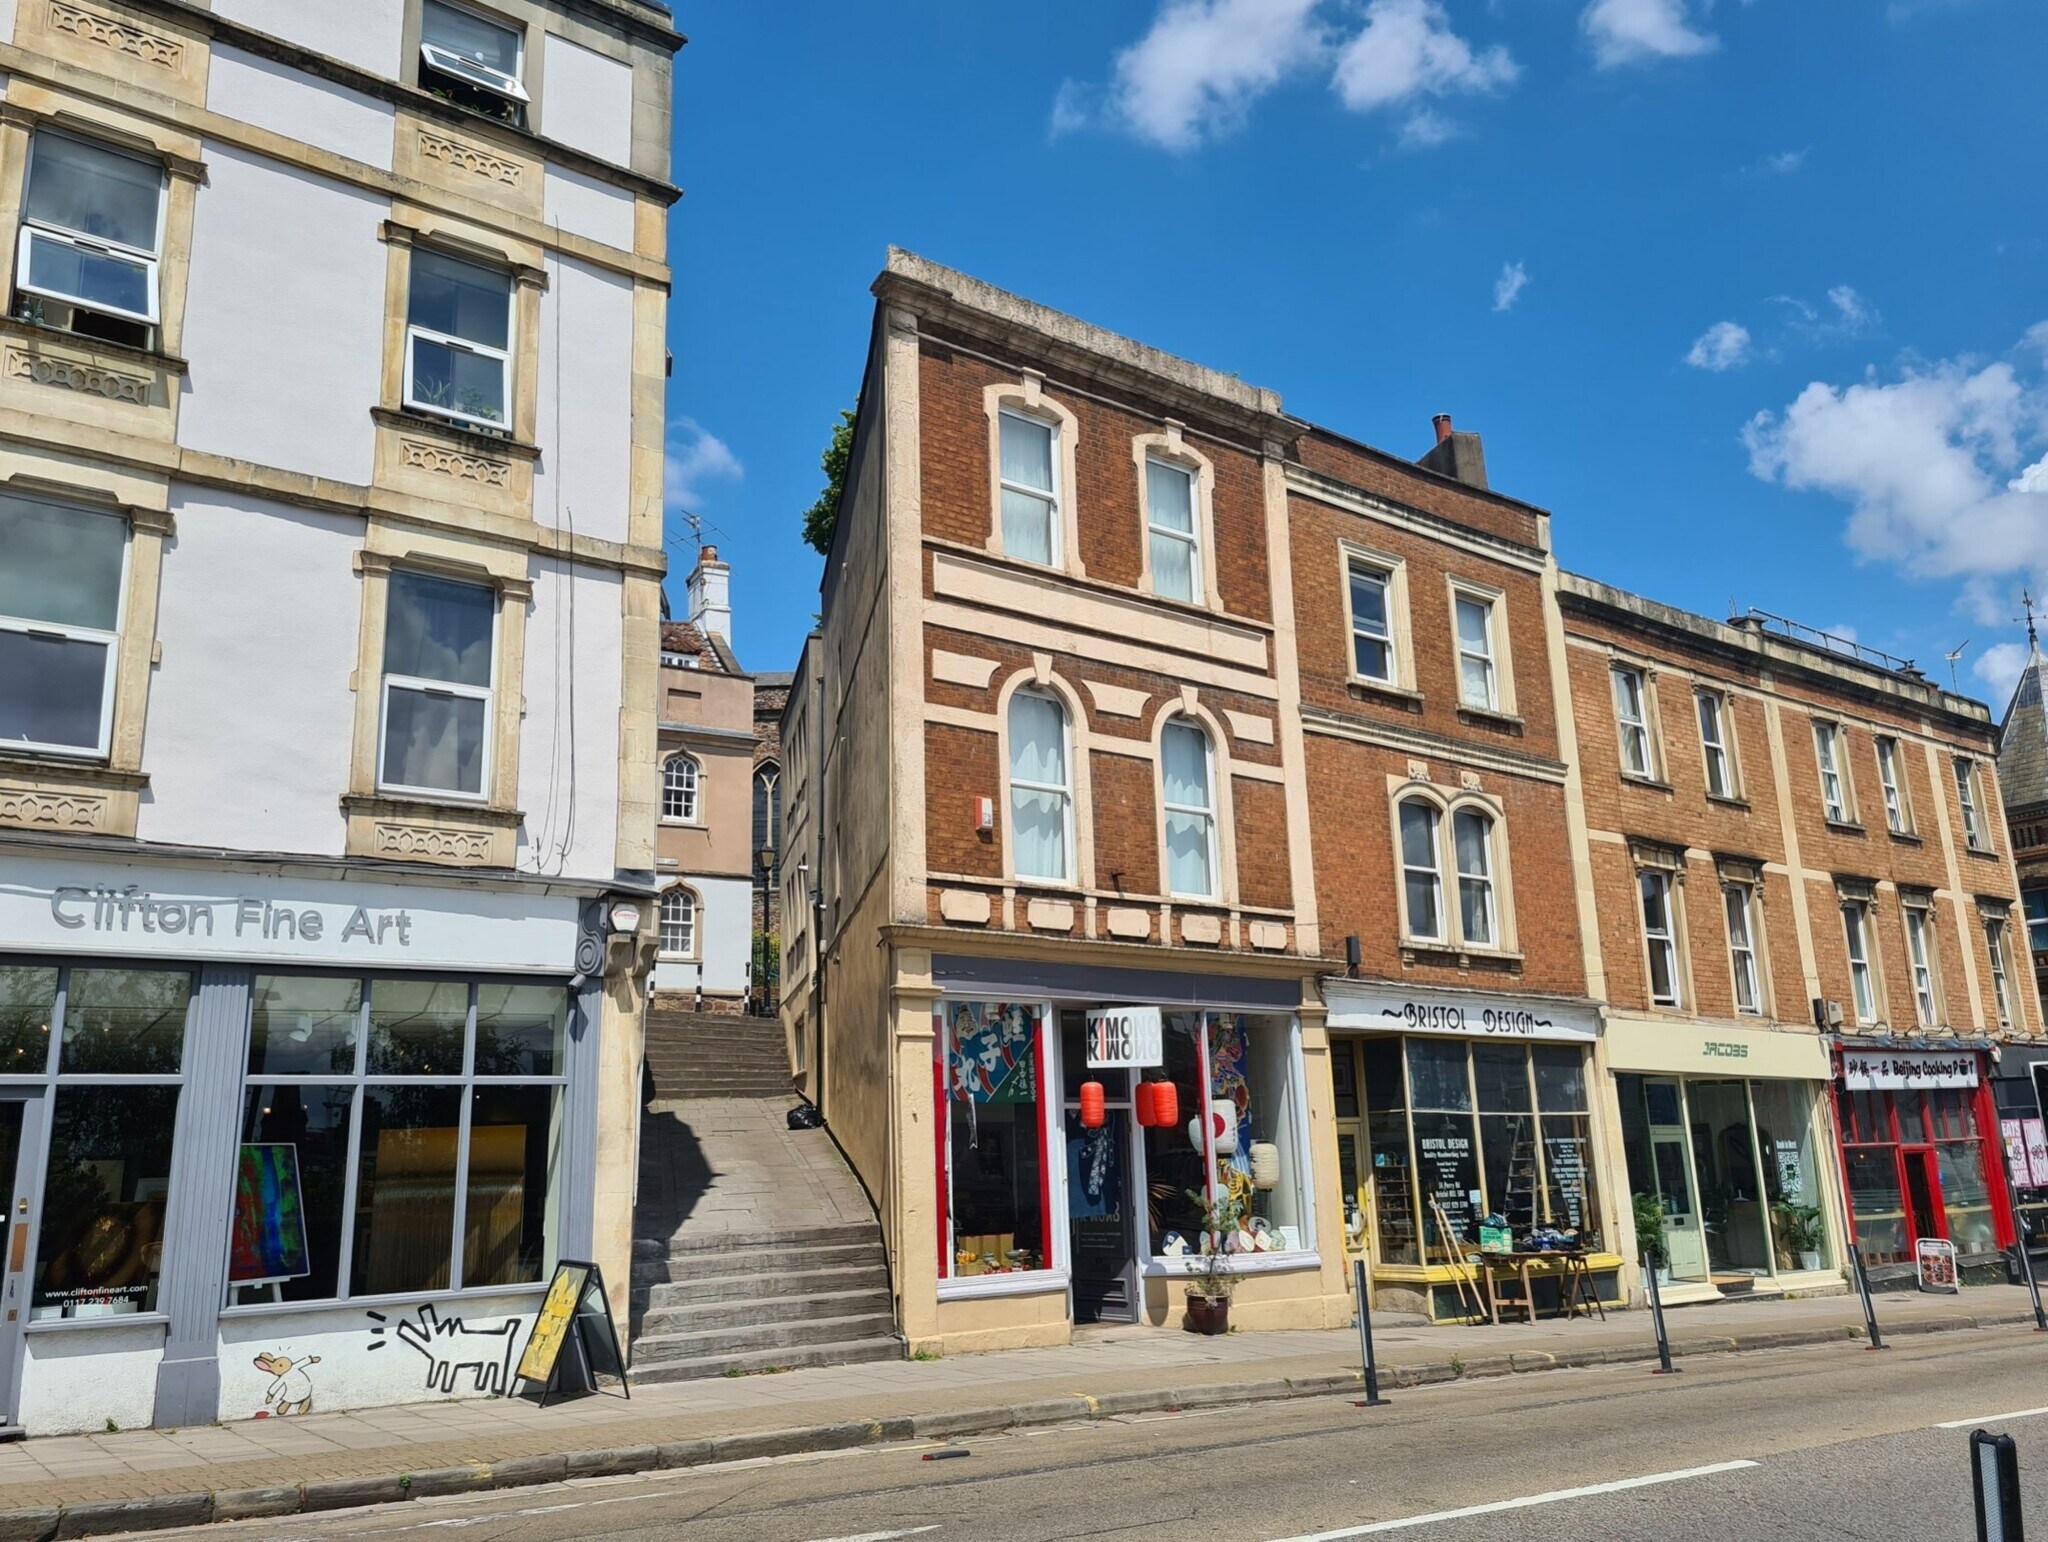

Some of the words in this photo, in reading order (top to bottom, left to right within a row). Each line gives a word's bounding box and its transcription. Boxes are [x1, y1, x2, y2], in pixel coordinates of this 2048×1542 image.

[52, 883, 214, 936] Clifton
[235, 895, 324, 941] Fine
[341, 904, 412, 946] Art
[1404, 1003, 1466, 1030] BRISTOL
[1482, 1008, 1534, 1034] DESIGN
[1087, 1015, 1160, 1041] KIMONO
[1703, 1042, 1748, 1058] JACOBS
[1892, 1060, 1921, 1079] Beijing
[1922, 1060, 1953, 1079] Cooking
[1422, 1138, 1447, 1150] BRISTOL
[1447, 1138, 1469, 1149] DESIGN
[45, 1285, 148, 1298] www.cliftonfineart.com
[63, 1299, 85, 1308] 0117
[88, 1297, 105, 1305] 239
[107, 1295, 129, 1304] 7684
